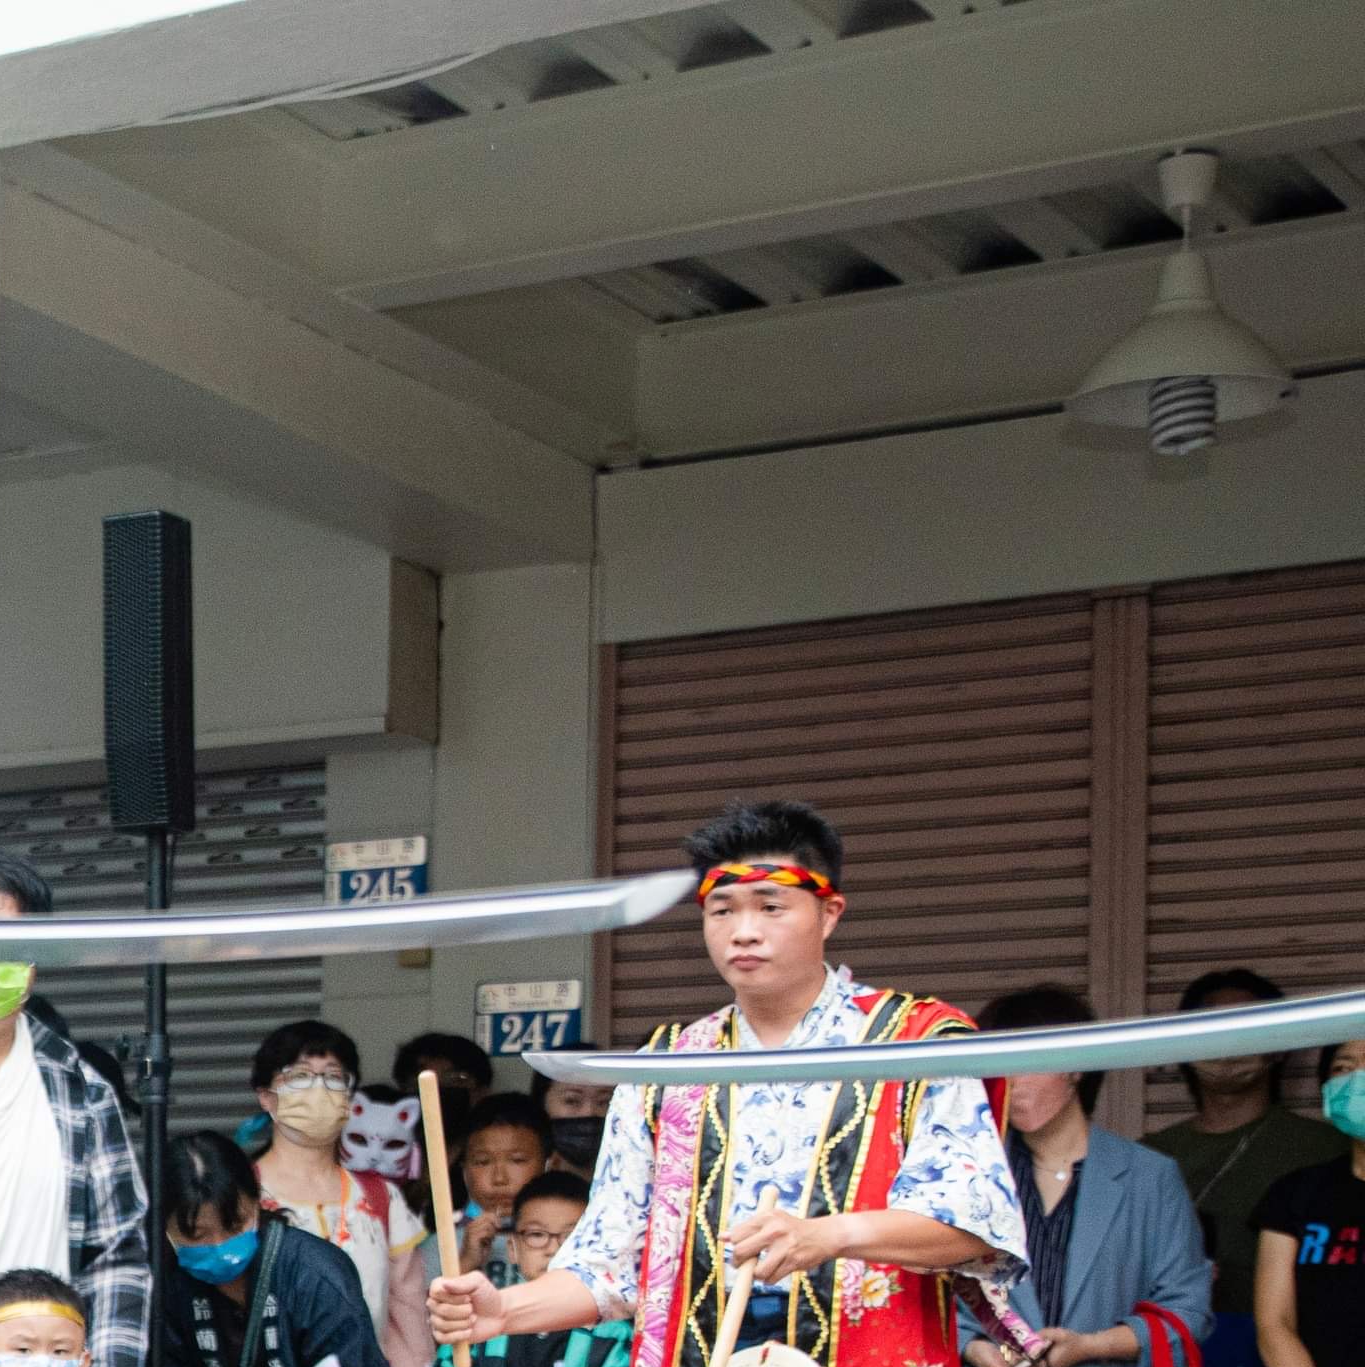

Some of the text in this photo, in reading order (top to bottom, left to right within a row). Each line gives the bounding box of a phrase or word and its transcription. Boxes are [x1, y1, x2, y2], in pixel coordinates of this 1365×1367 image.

[349, 869, 415, 904] 245
[500, 1012, 571, 1053] 247
[1297, 1222, 1365, 1265] RA
